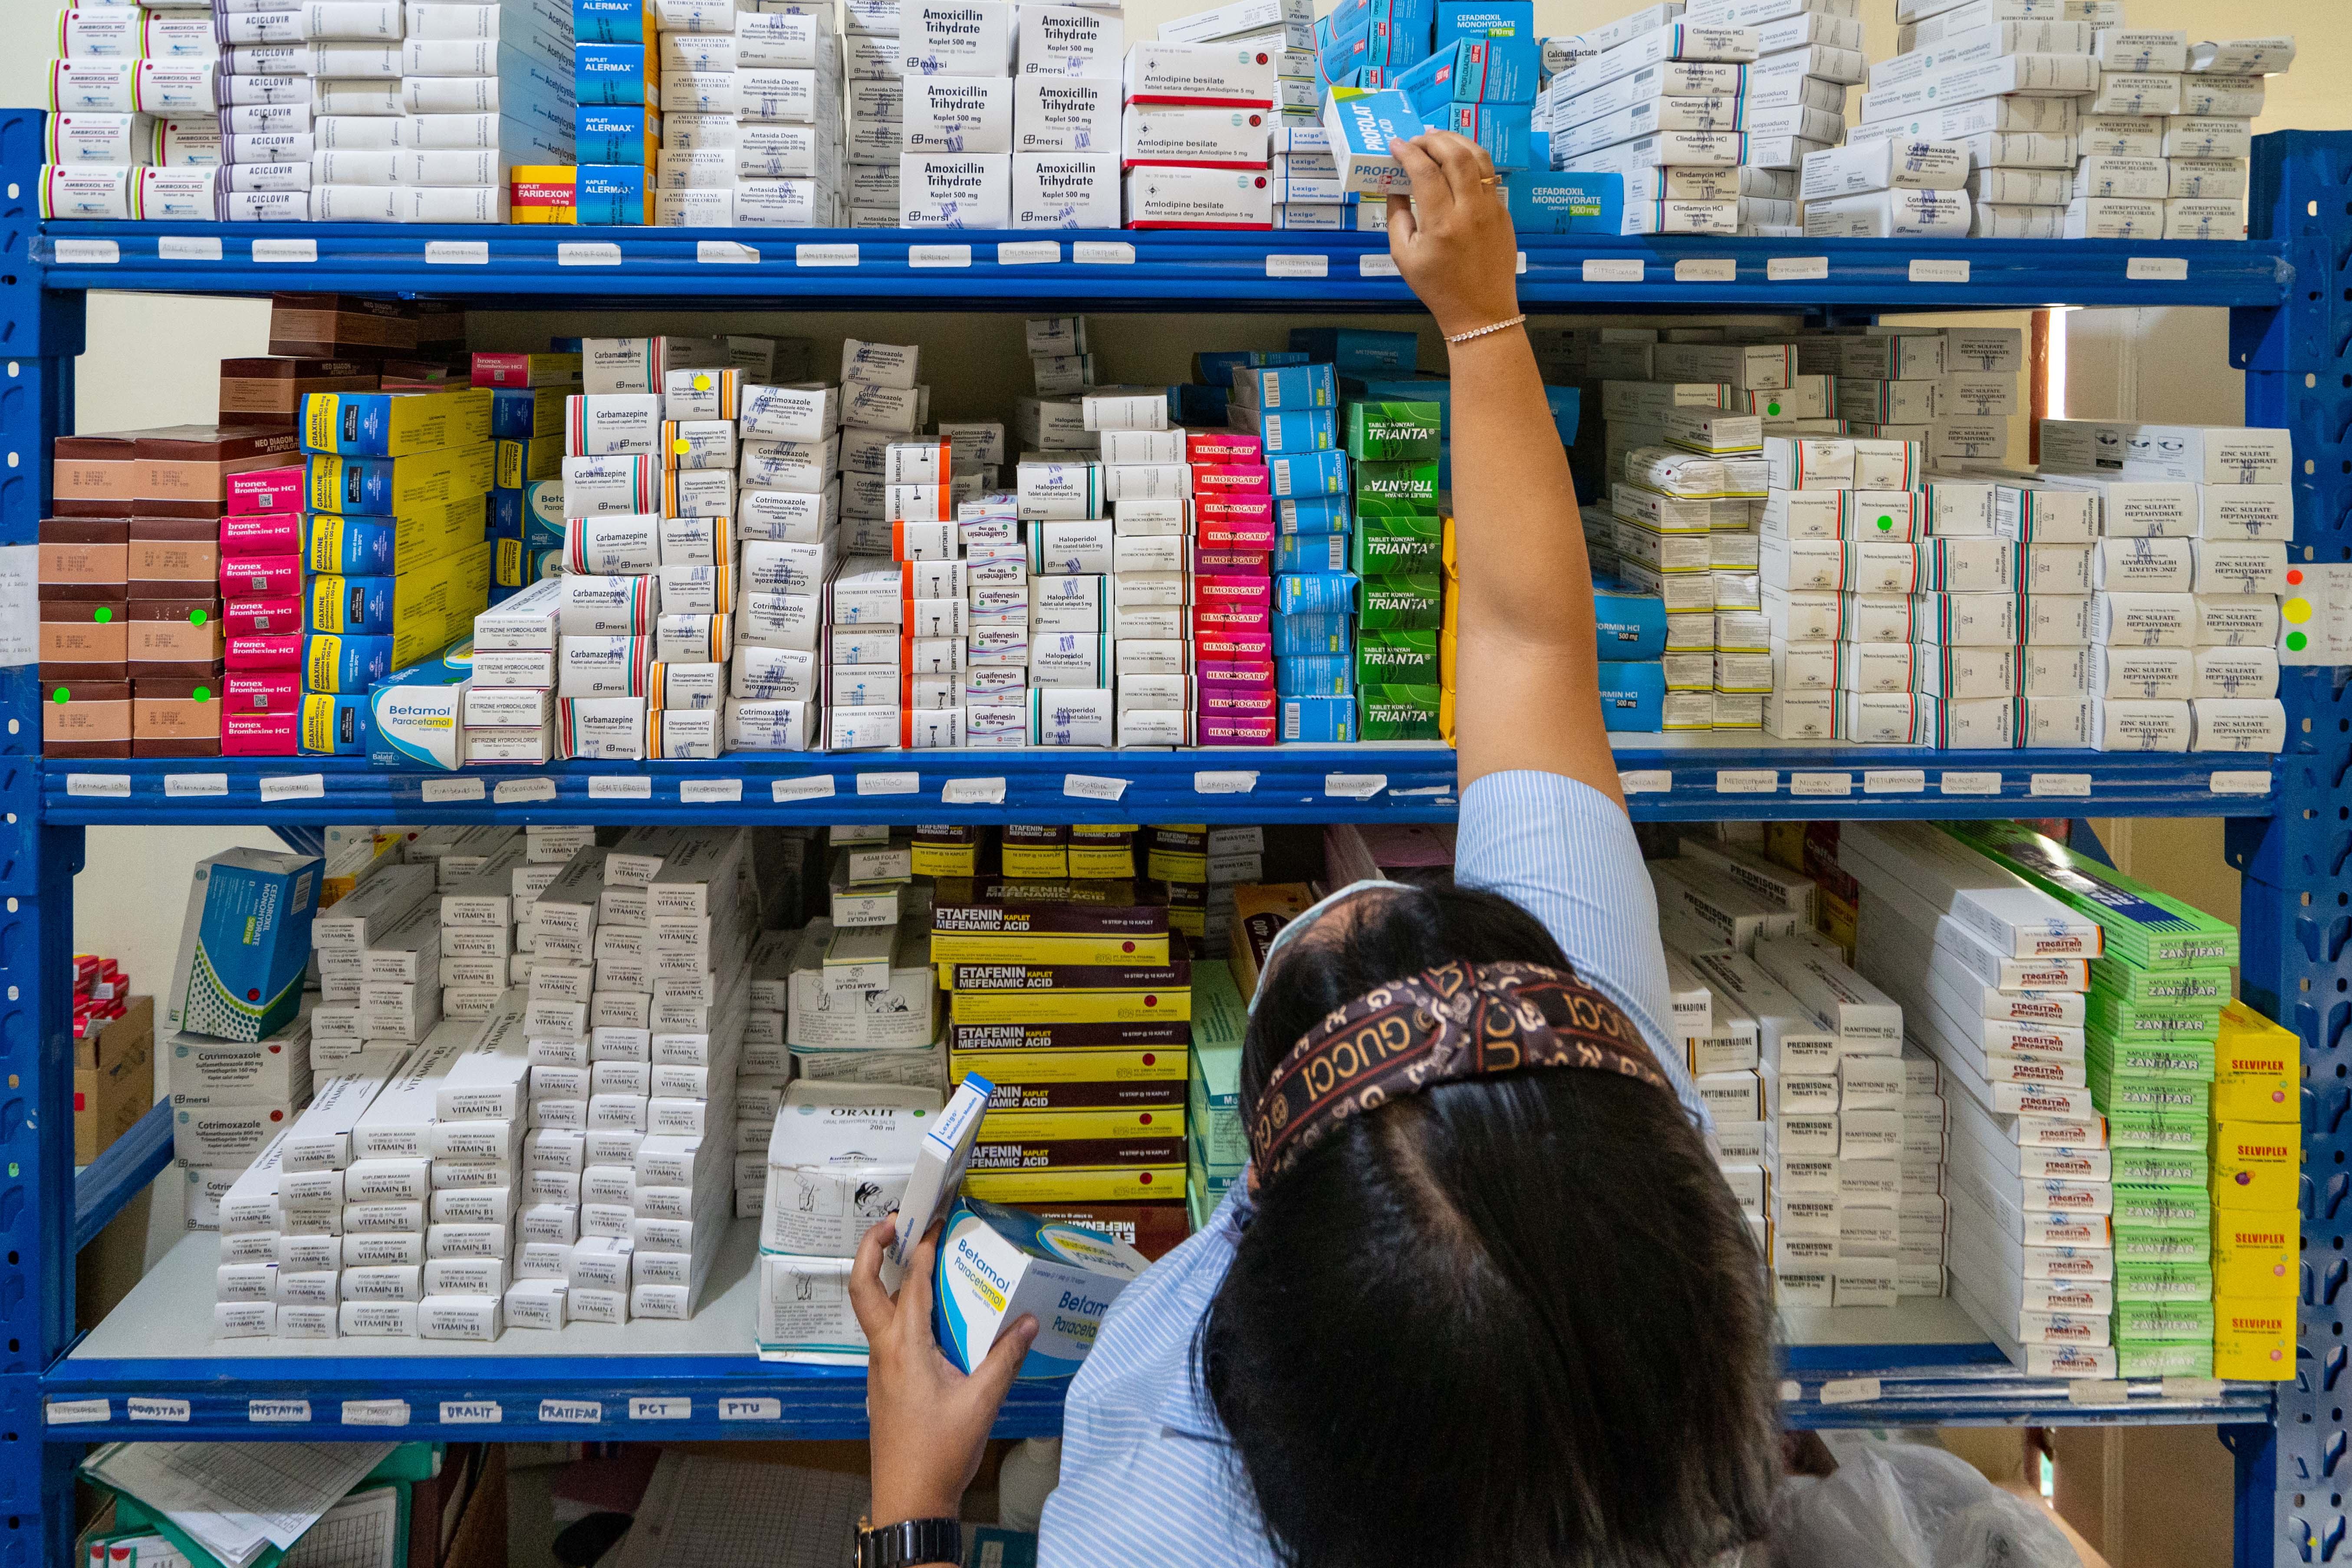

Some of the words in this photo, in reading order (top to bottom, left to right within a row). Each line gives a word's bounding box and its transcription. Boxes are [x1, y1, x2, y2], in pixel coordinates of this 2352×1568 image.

[246, 16, 289, 25] ACICLOVIR
[923, 9, 983, 22] Amoxicillin
[1042, 16, 1099, 28] Amoxicillin
[926, 21, 980, 34] Trihydrate
[1044, 28, 1097, 41] Trihydrate
[929, 38, 950, 46] Kaplet
[1547, 50, 1573, 58] Calcium
[1575, 49, 1597, 57] Lactate
[249, 78, 293, 87] ACICLOVIR
[1145, 76, 1189, 85] Amlodipine
[1676, 171, 1714, 180] Clindamycin
[1533, 187, 1584, 196] CEFADROXIL
[247, 194, 289, 204] ACICLOVIR
[1145, 201, 1189, 210] Amlodipine
[1571, 206, 1585, 215] 500
[596, 410, 648, 420] Carbamazepine
[254, 439, 267, 448] NEO
[270, 436, 293, 446] DIAGON
[756, 496, 806, 506] Cotrimoxazole
[979, 592, 1019, 602] Guaifenesin
[389, 705, 450, 716] Betamol
[392, 718, 450, 727] Paracetamol
[583, 716, 633, 725] Carbamazepine
[975, 713, 1015, 722] Guaifenesin
[937, 909, 1003, 920] ETAFENIN
[937, 920, 1001, 930] MEFENAMIC
[1003, 920, 1030, 930] ACID
[960, 966, 1026, 978] ETAFENIN
[959, 977, 1024, 988] MEFENAMIC
[1026, 977, 1053, 987] ACID
[1702, 1037, 1752, 1047] PHYTOMENADIONE
[198, 1051, 261, 1060] Cotrimoxazole
[1303, 1016, 1411, 1102] GUCCI
[2232, 1059, 2283, 1070] SELVIPLEX
[831, 1108, 895, 1118] ORALIT
[2235, 1233, 2284, 1243] SELVIPLEX
[957, 1237, 1012, 1294] Betamol
[954, 1256, 1004, 1308] Paracetamol
[447, 1405, 494, 1419] ORALIT
[540, 1406, 599, 1420] PRATIFAR
[638, 1405, 666, 1415] PCT
[728, 1402, 760, 1414] PTU
